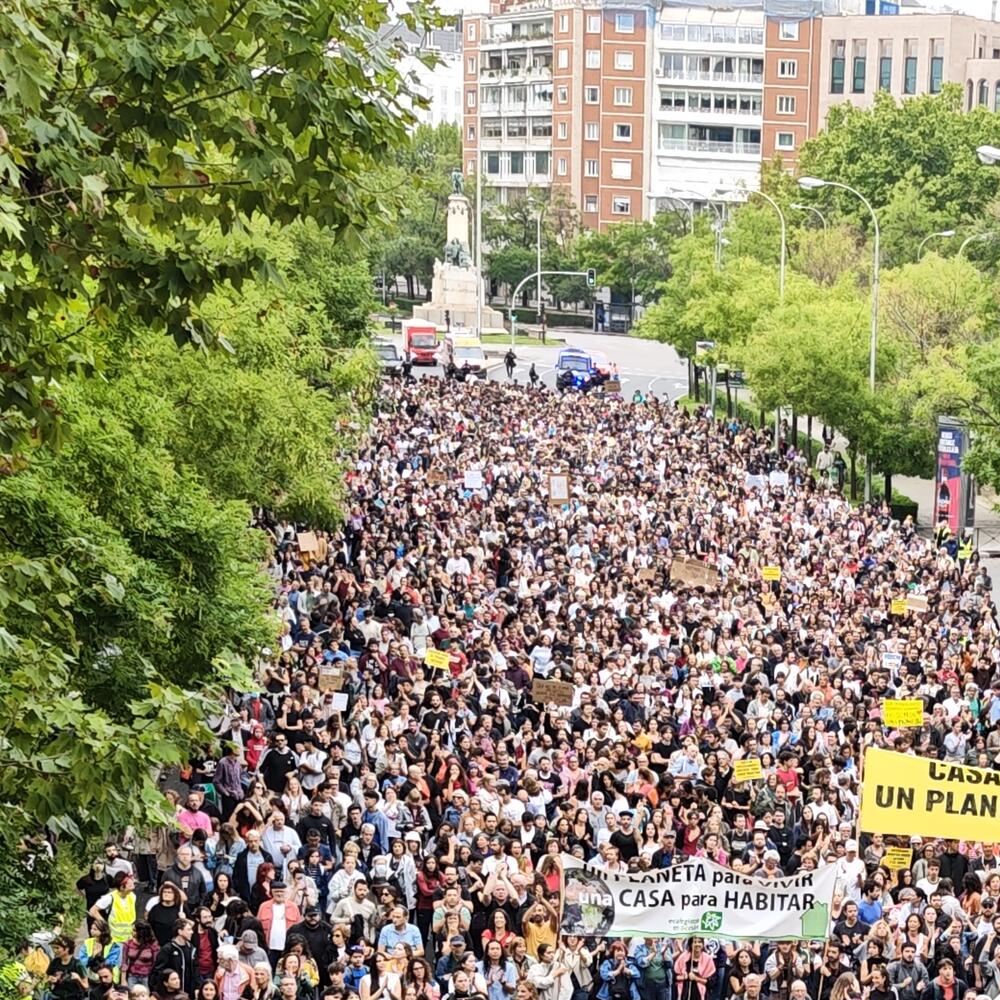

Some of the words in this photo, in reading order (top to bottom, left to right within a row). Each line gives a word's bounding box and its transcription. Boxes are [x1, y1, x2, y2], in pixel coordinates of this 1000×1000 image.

[875, 784, 915, 811] UN
[578, 892, 613, 907] una
[618, 888, 676, 908] CASA
[681, 893, 718, 910] para
[723, 890, 815, 911] HABITAR
